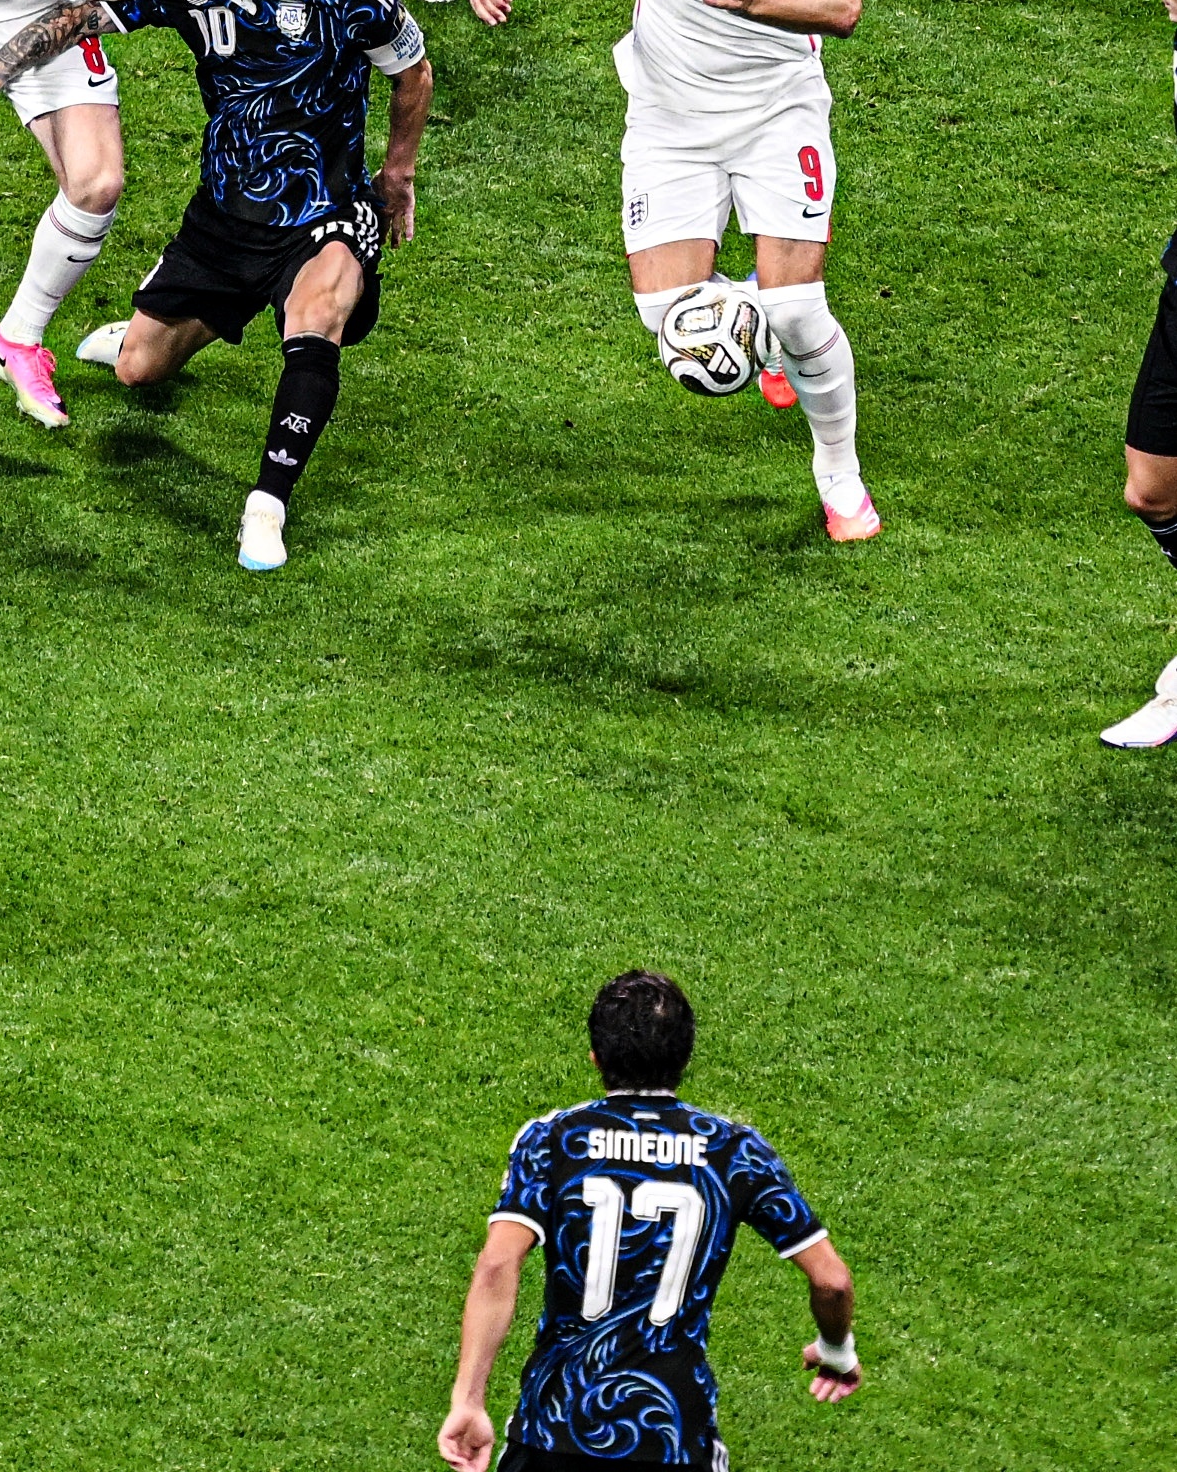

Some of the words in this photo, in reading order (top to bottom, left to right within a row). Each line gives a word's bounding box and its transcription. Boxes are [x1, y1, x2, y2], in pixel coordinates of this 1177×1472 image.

[78, 34, 106, 75] 8
[188, 6, 236, 57] 10
[798, 146, 823, 202] 9
[588, 1128, 708, 1167] SIMEONE
[582, 1176, 705, 1327] 17
